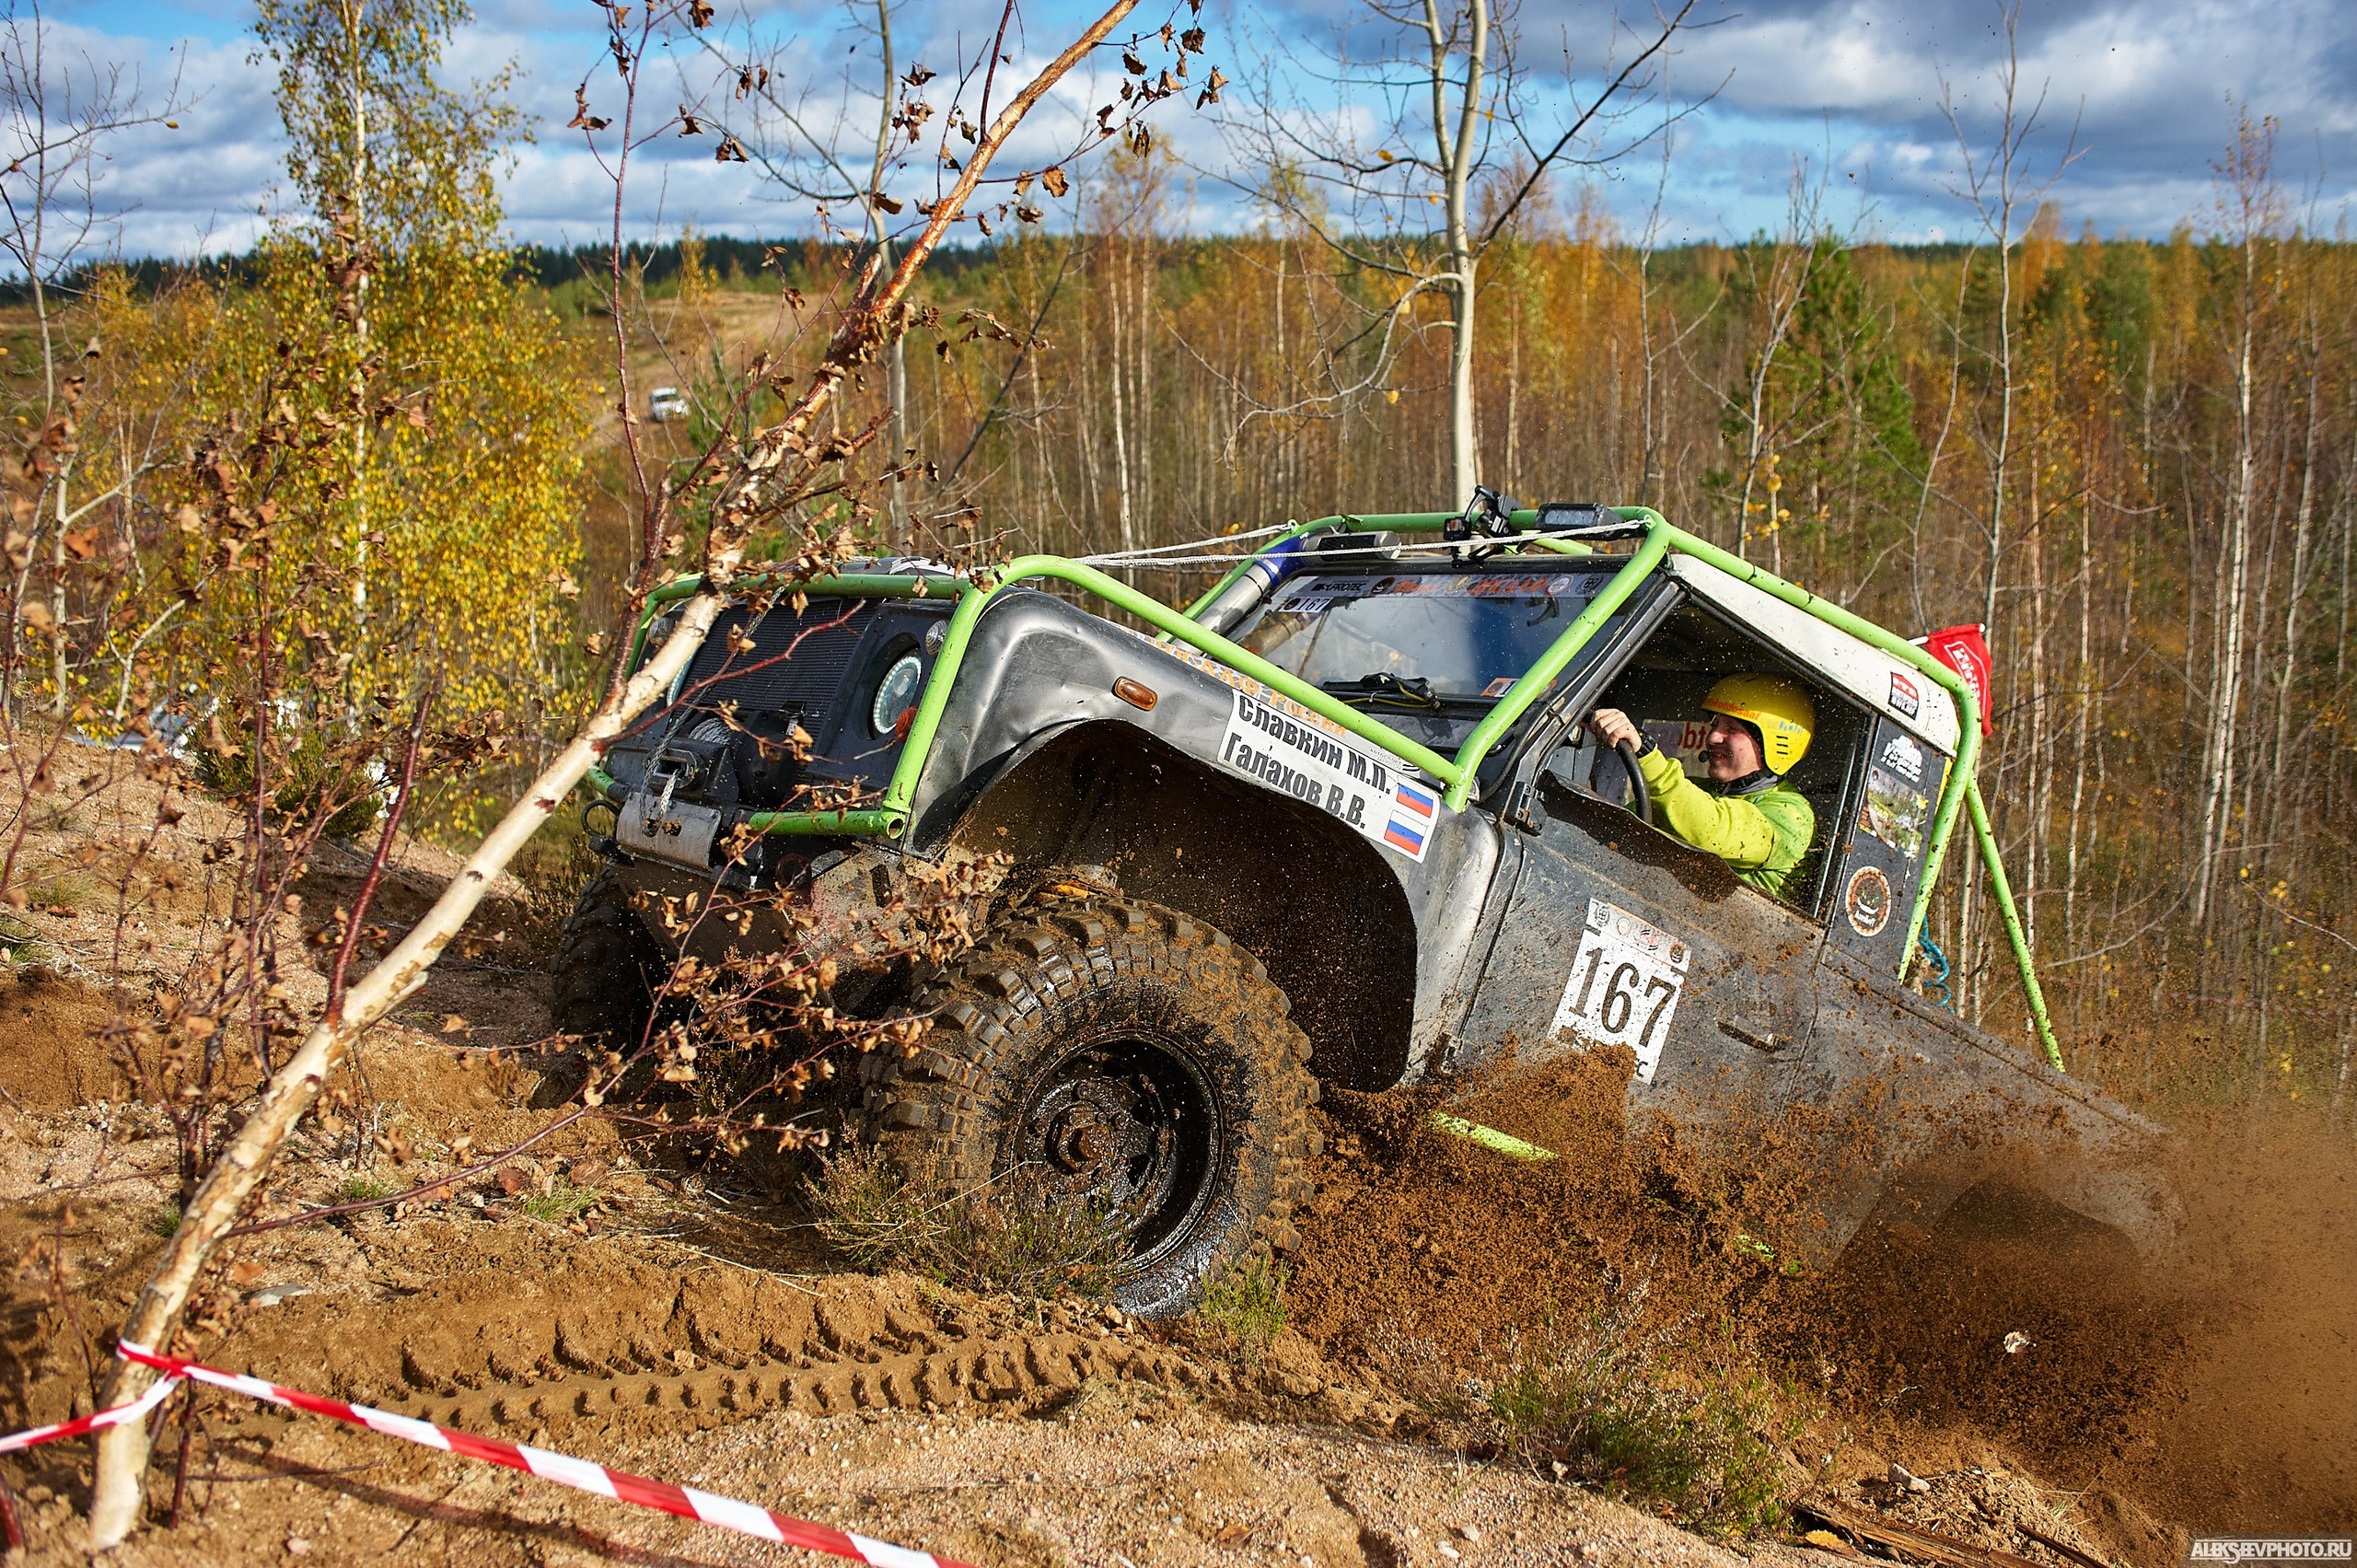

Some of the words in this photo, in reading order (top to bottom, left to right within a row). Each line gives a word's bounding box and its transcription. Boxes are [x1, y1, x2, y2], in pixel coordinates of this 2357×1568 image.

[1297, 598, 1329, 611] 167
[1237, 694, 1343, 771] Славкин
[1346, 749, 1390, 795] М.П.
[1270, 689, 1346, 738] России
[1223, 732, 1324, 806] Галахов
[1326, 783, 1365, 830] В.В.
[1567, 947, 1678, 1048] 167
